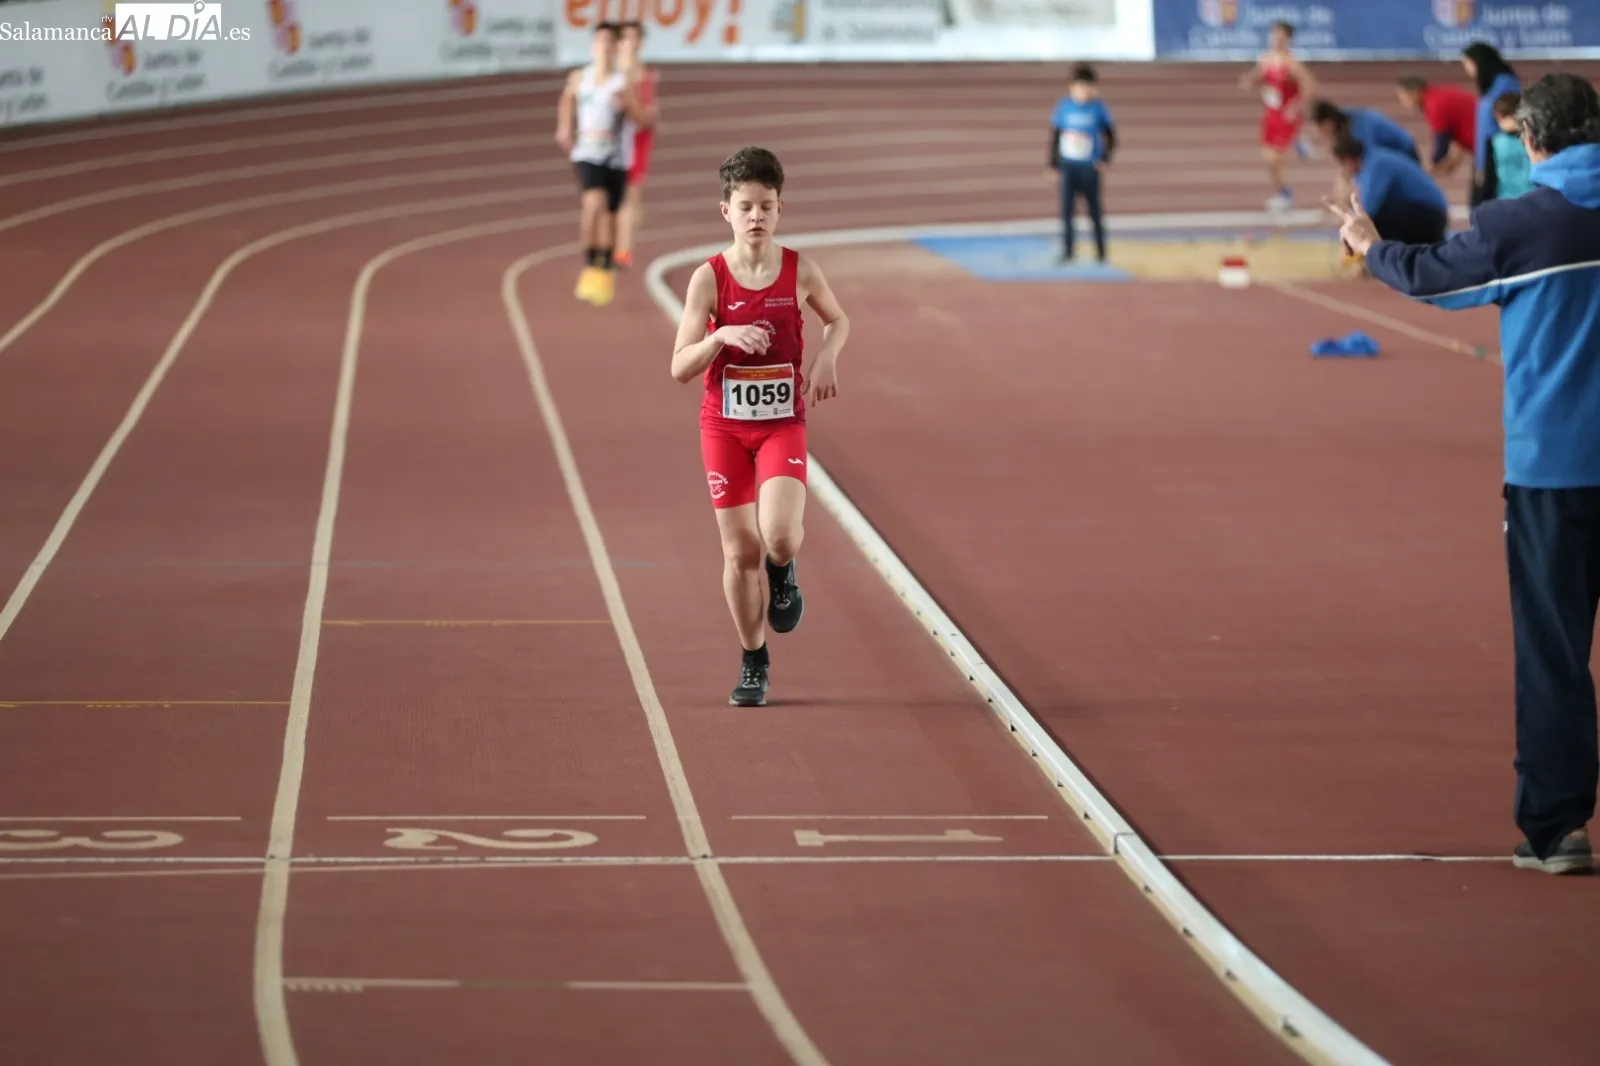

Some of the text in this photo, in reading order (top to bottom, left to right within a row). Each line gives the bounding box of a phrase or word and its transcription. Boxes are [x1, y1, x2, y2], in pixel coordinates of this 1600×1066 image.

[731, 382, 791, 407] 1059
[384, 828, 598, 850] 2
[793, 829, 1003, 847] 1
